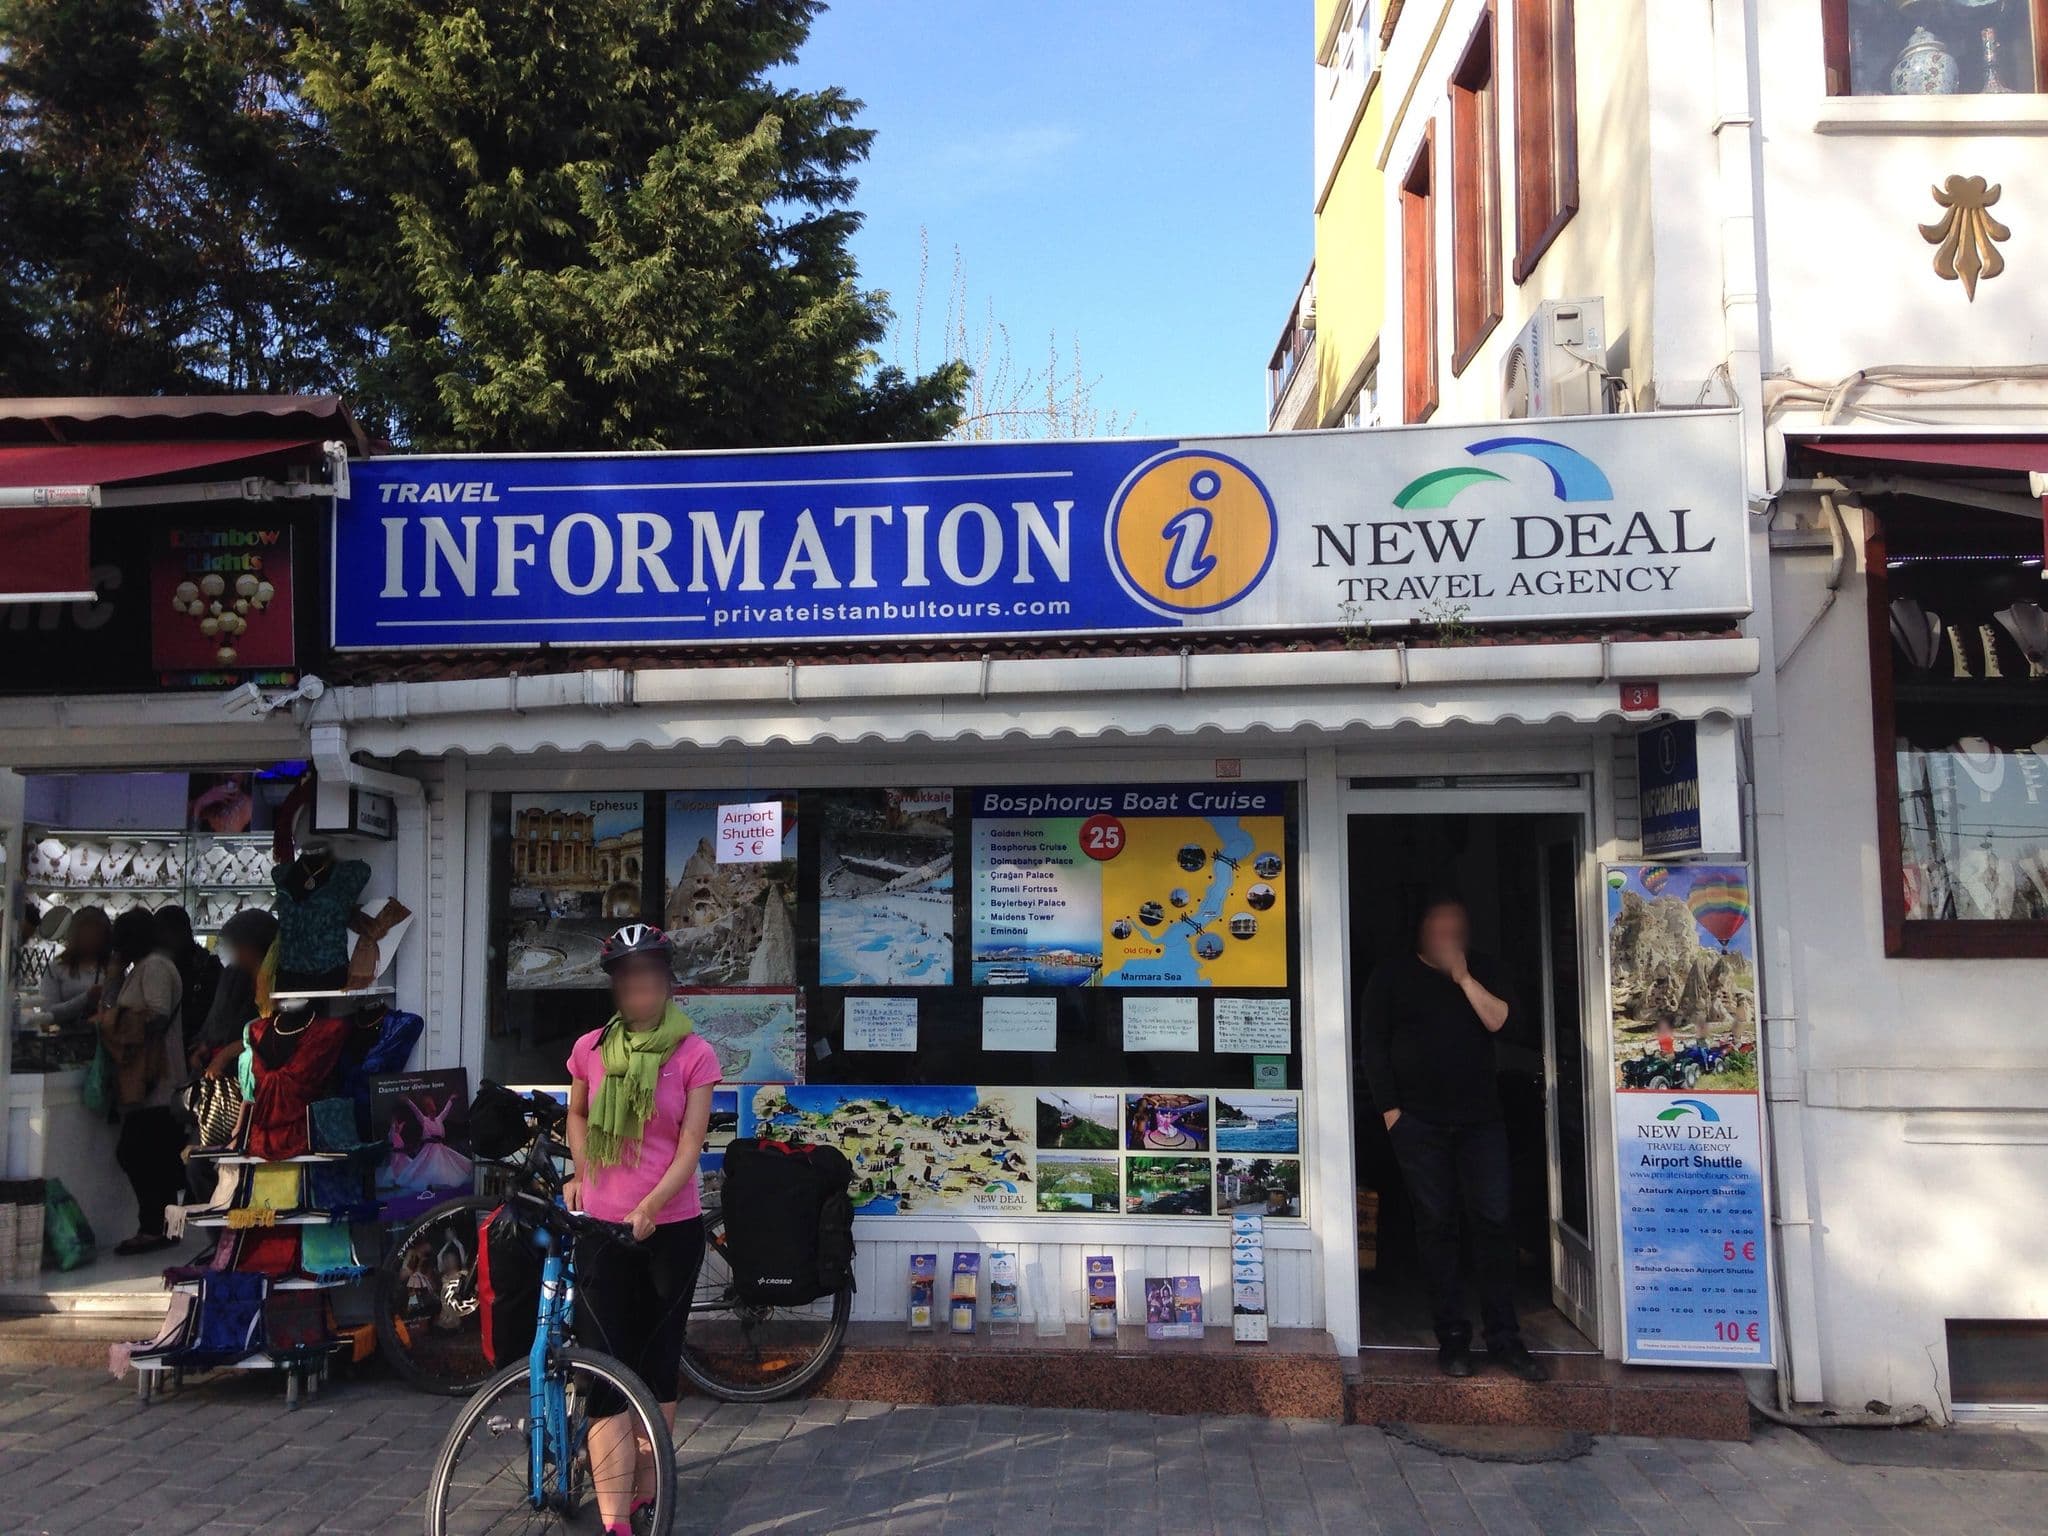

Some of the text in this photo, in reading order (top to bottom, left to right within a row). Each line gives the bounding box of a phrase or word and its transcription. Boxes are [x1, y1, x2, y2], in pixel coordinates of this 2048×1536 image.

[379, 482, 501, 504] TRAVEL
[1311, 509, 1715, 569] NEW DEAL
[379, 500, 1075, 599] INFORMATION
[1337, 566, 1681, 603] TRAVEL AGENCY
[713, 598, 1070, 627] privateistanbultours.com
[589, 799, 639, 814] Ephesus
[983, 790, 1266, 815] Bosphorus Boat Cruise
[723, 809, 774, 825] Airport
[722, 825, 775, 841] Shuttle
[990, 829, 1044, 838] Golden Horn
[1089, 826, 1120, 849] 25
[734, 841, 764, 857] 5 €
[990, 843, 1067, 854] Bosphorus Cruise
[1045, 857, 1074, 866] Palace
[1026, 871, 1055, 880] Palace
[990, 885, 1058, 894] Rumeli Fortress
[990, 899, 1066, 909] Beylerbeyi Palace
[990, 913, 1055, 921] Maidens Tower
[1123, 947, 1153, 957] Old City
[1121, 972, 1182, 982] Marmara Sea
[1637, 1124, 1738, 1140] NEW DEAL
[1647, 1142, 1731, 1152] TRAVEL AGENCY
[1640, 1154, 1743, 1170] Airport Shuttle
[973, 1194, 1027, 1204] NEW DEAL
[1676, 1188, 1710, 1196] Airport
[1712, 1188, 1746, 1196] Shuttle
[1723, 1240, 1756, 1261] 5 €
[1714, 1321, 1760, 1342] 10 €
